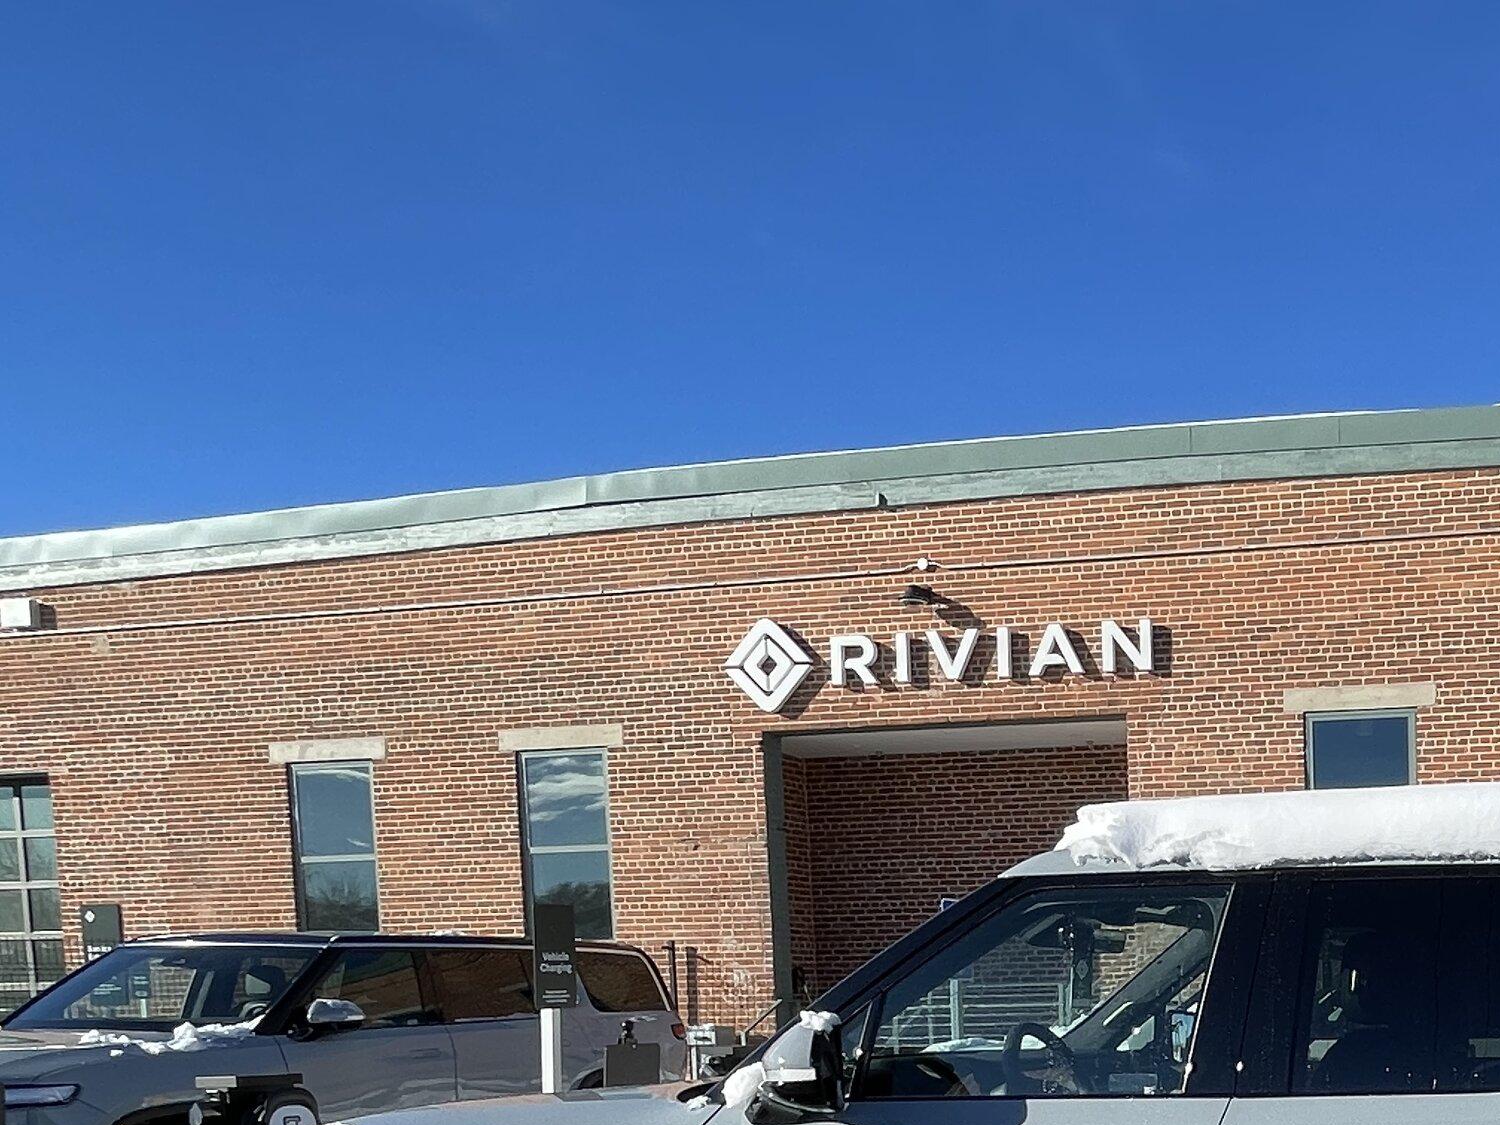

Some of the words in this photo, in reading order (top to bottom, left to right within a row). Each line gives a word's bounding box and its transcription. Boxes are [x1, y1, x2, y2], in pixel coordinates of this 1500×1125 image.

[829, 617, 1154, 686] RIVIAN
[541, 951, 570, 961] Vehicle
[540, 963, 572, 974] Charging
